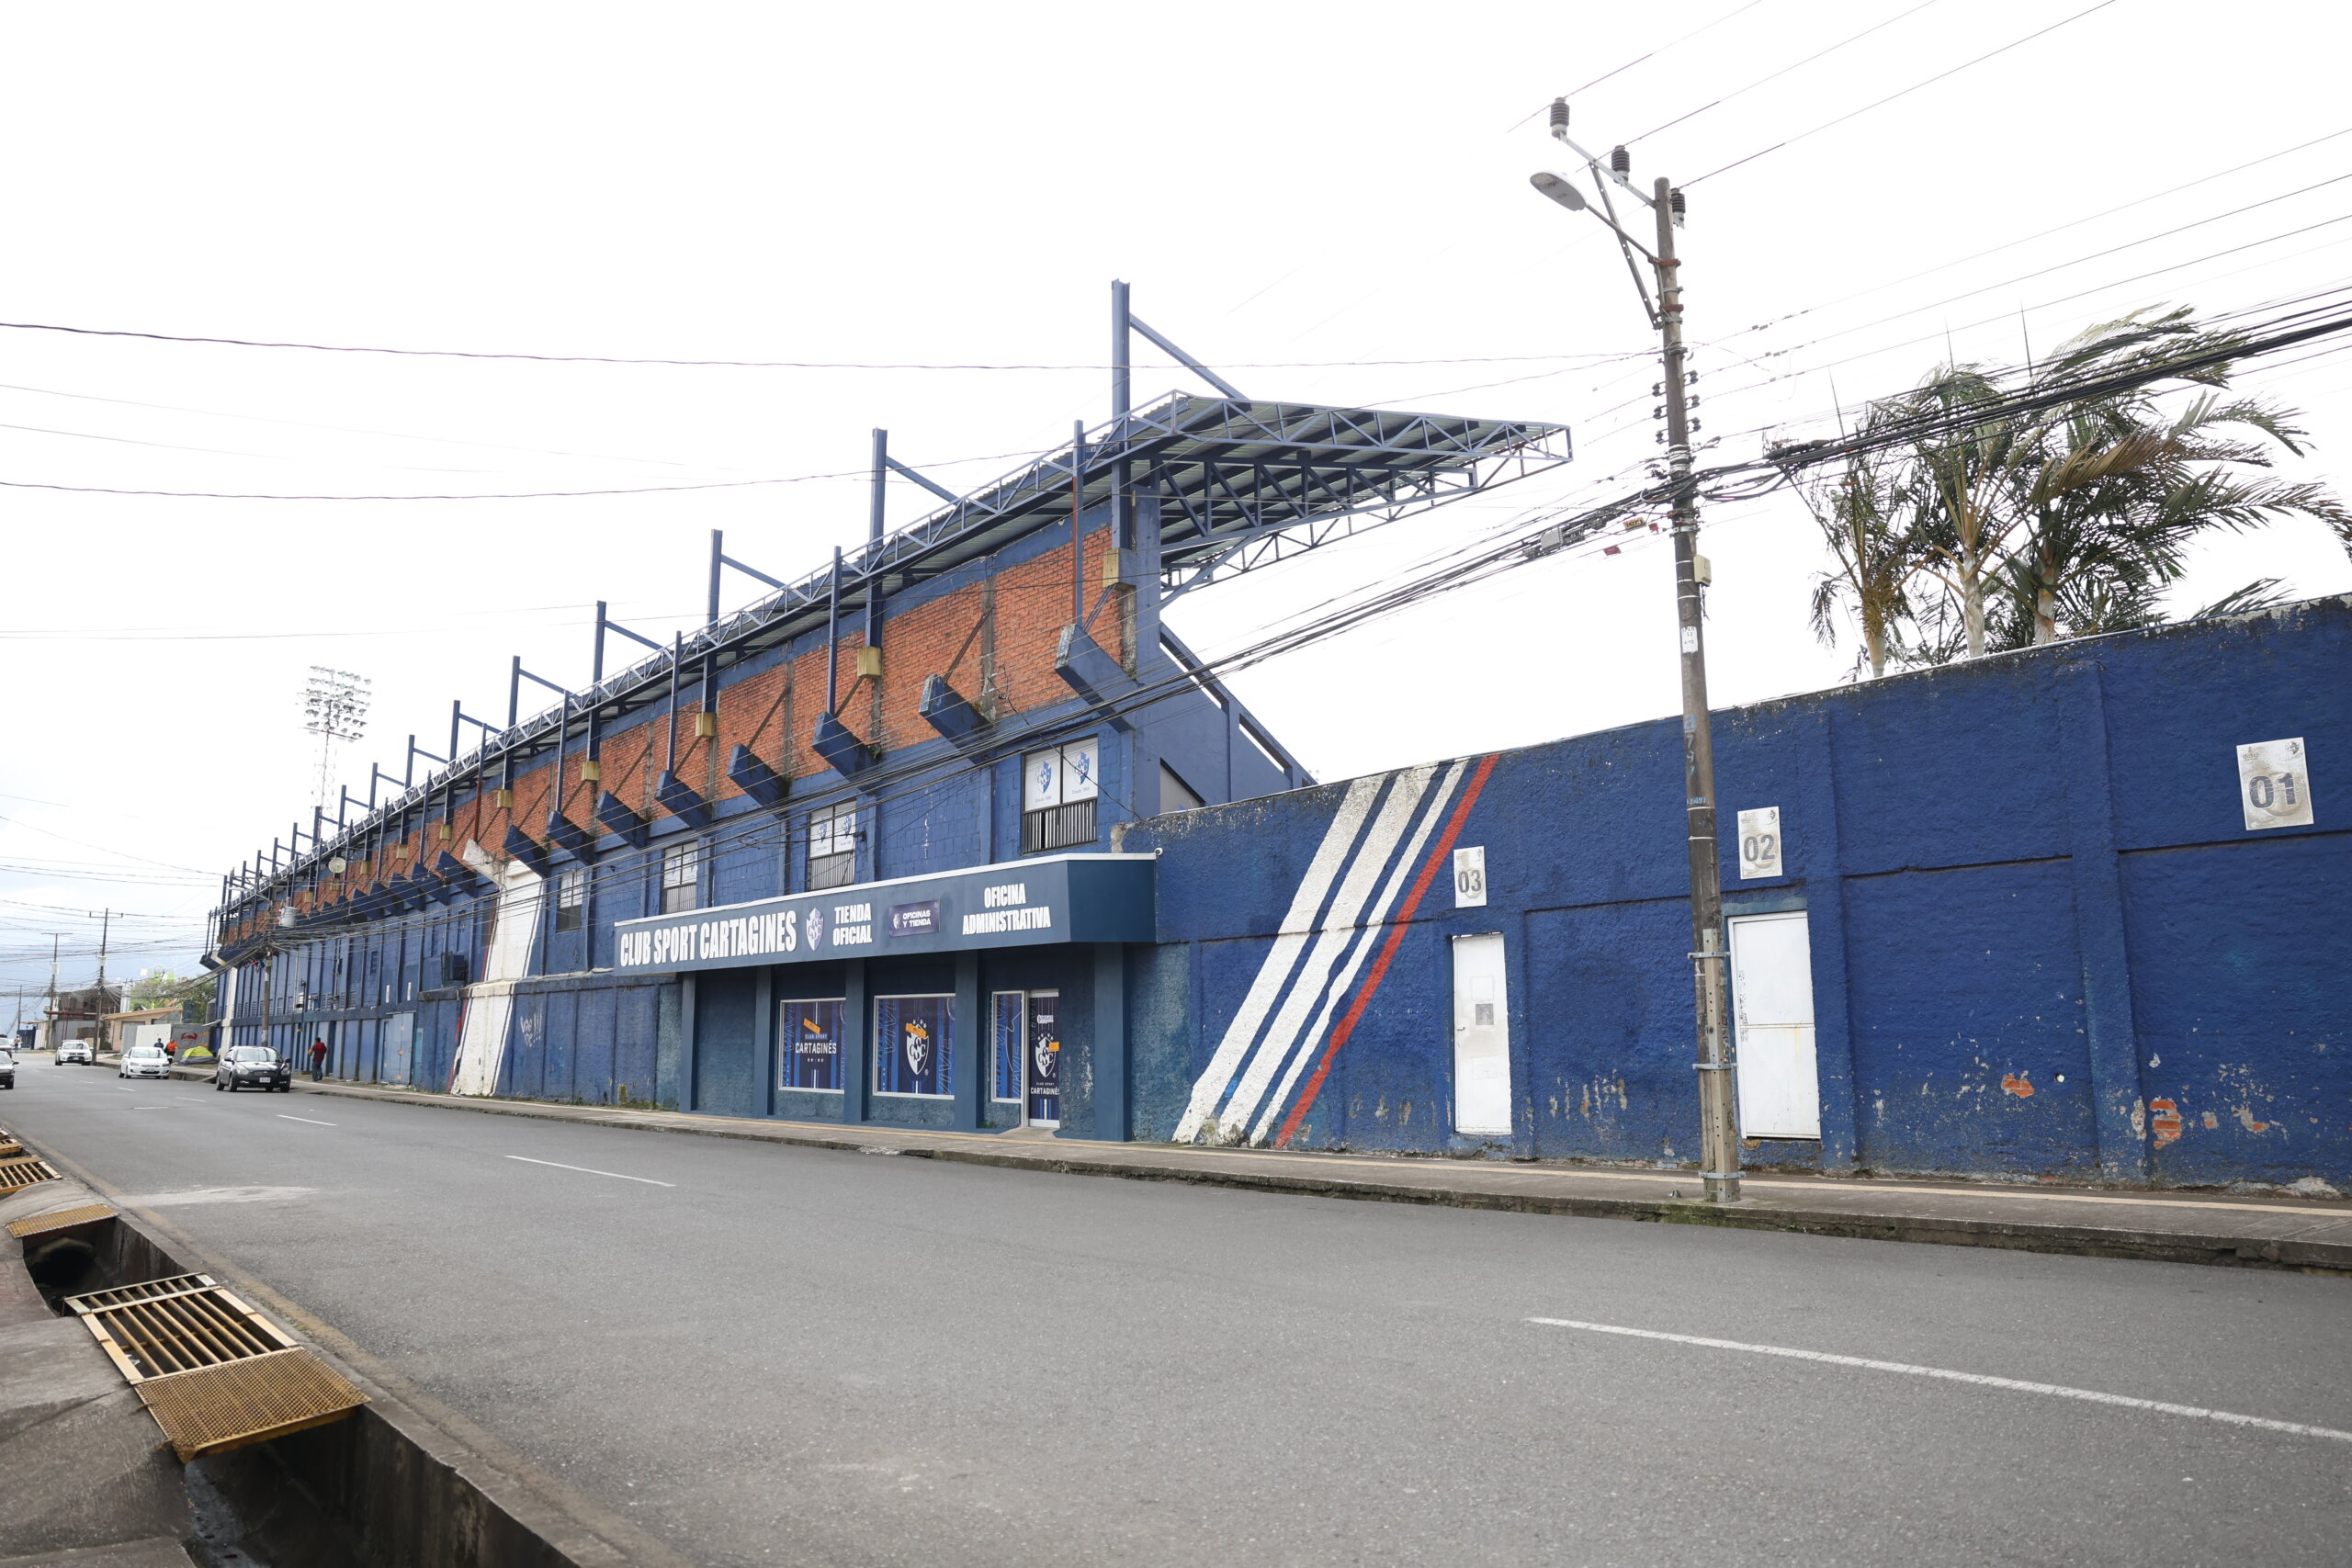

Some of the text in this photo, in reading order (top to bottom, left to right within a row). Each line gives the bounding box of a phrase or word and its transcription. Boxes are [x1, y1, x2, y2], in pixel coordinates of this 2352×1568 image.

[2249, 773, 2296, 808] 01
[1744, 834, 1776, 862] 02
[1457, 870, 1482, 893] 03
[984, 883, 1027, 908] OFICINA
[834, 903, 872, 924] TIENDA
[902, 909, 931, 920] OFICINAS
[909, 918, 932, 928] TIENDA
[963, 907, 1052, 935] ADMINISTRATIVA
[620, 910, 797, 967] CLUB SPORT CARTAGINES
[832, 925, 873, 946] OFICIAL
[795, 1040, 837, 1055] CARTAGINÉS
